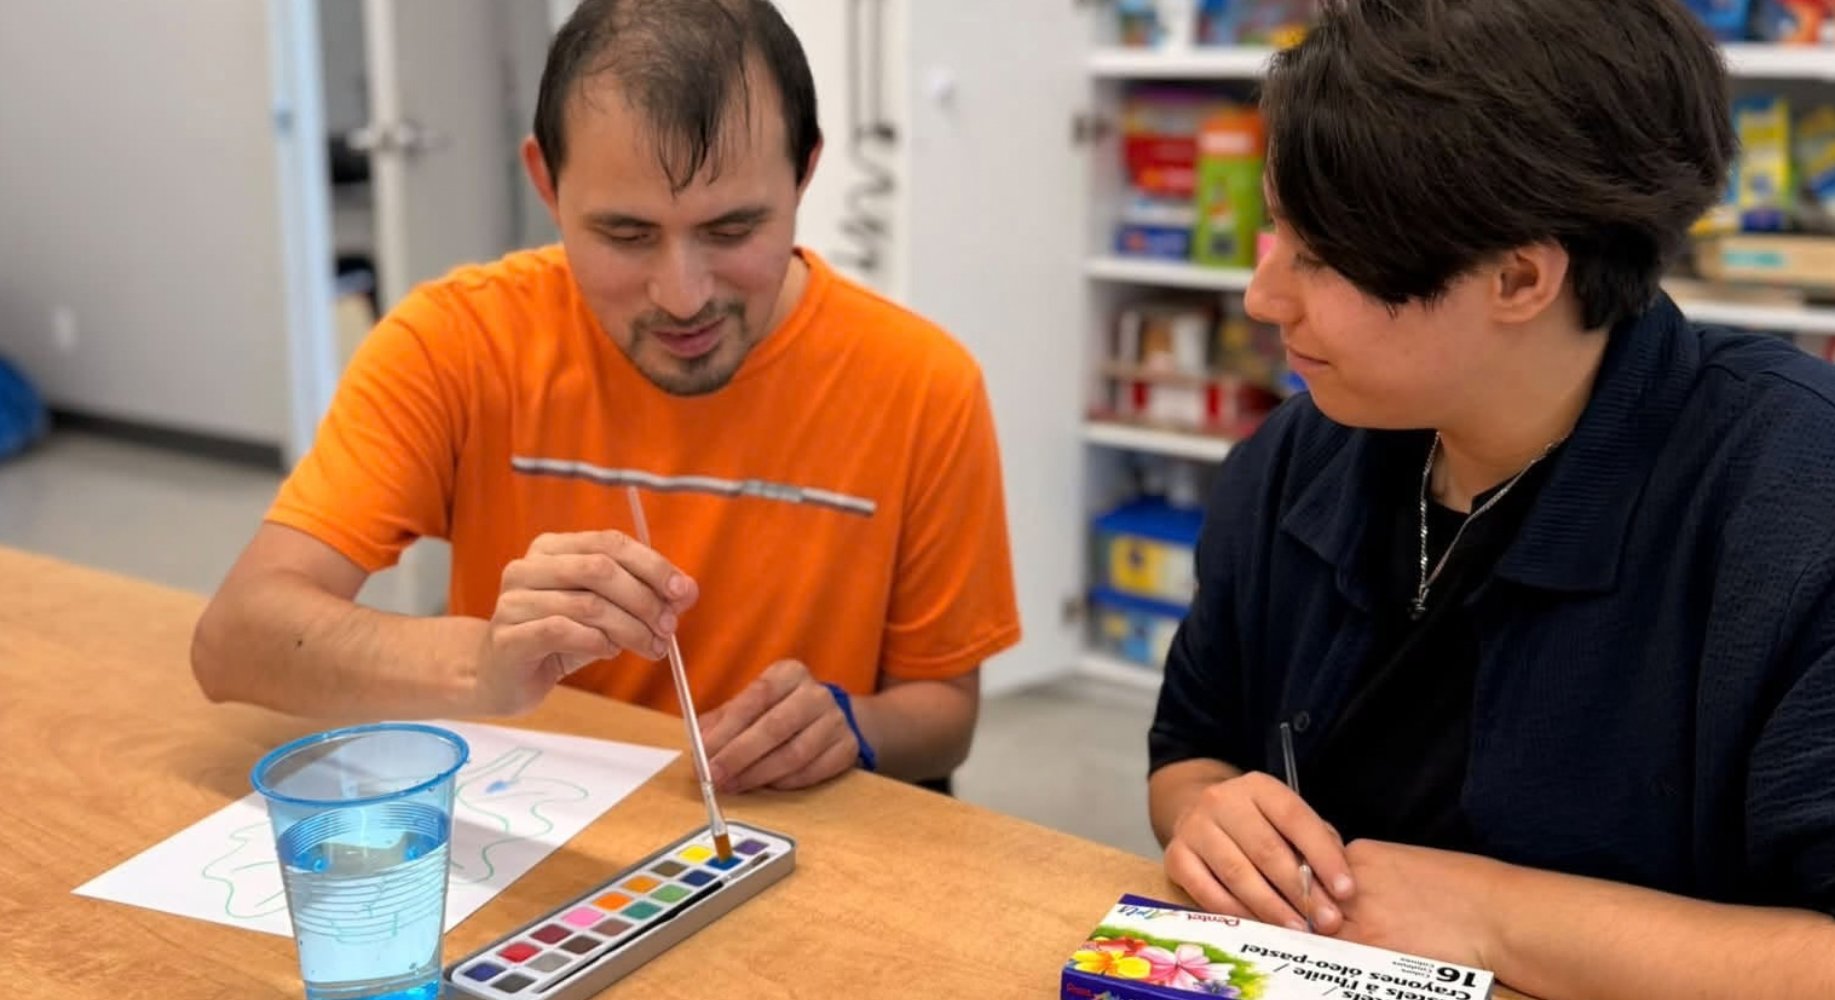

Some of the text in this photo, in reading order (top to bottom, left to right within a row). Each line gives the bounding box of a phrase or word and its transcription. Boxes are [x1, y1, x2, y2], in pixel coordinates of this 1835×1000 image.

[1187, 913, 1240, 927] Pentel
[1240, 944, 1472, 1000] Crayones óleo-pastel
[1293, 967, 1359, 990] l'huile
[1435, 966, 1477, 988] 16
[1365, 983, 1380, 995] à
